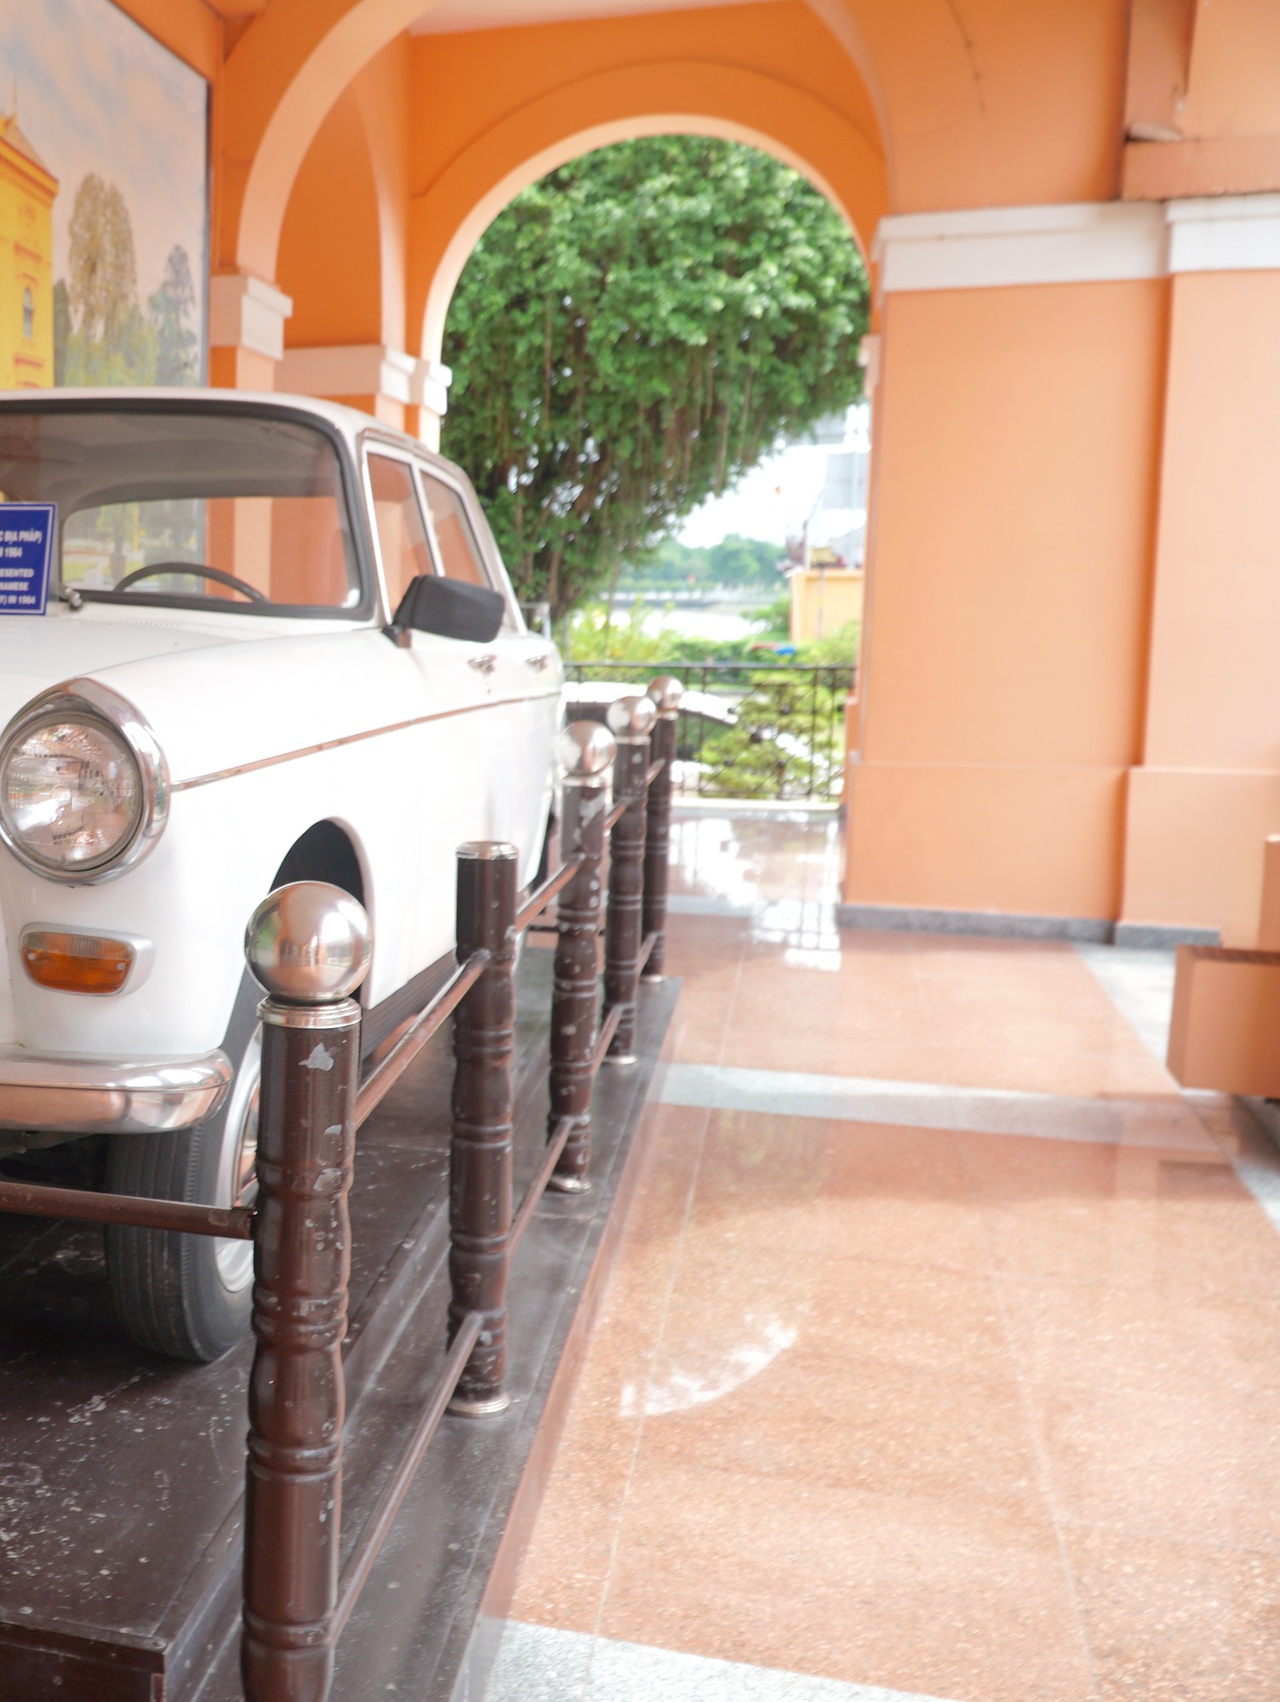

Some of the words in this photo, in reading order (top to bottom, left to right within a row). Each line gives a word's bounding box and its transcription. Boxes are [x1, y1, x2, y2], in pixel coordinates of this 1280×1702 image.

[18, 527, 43, 544] PHÁP)
[5, 546, 23, 558] 1964
[8, 595, 17, 604] IN
[18, 595, 36, 605] 1964
